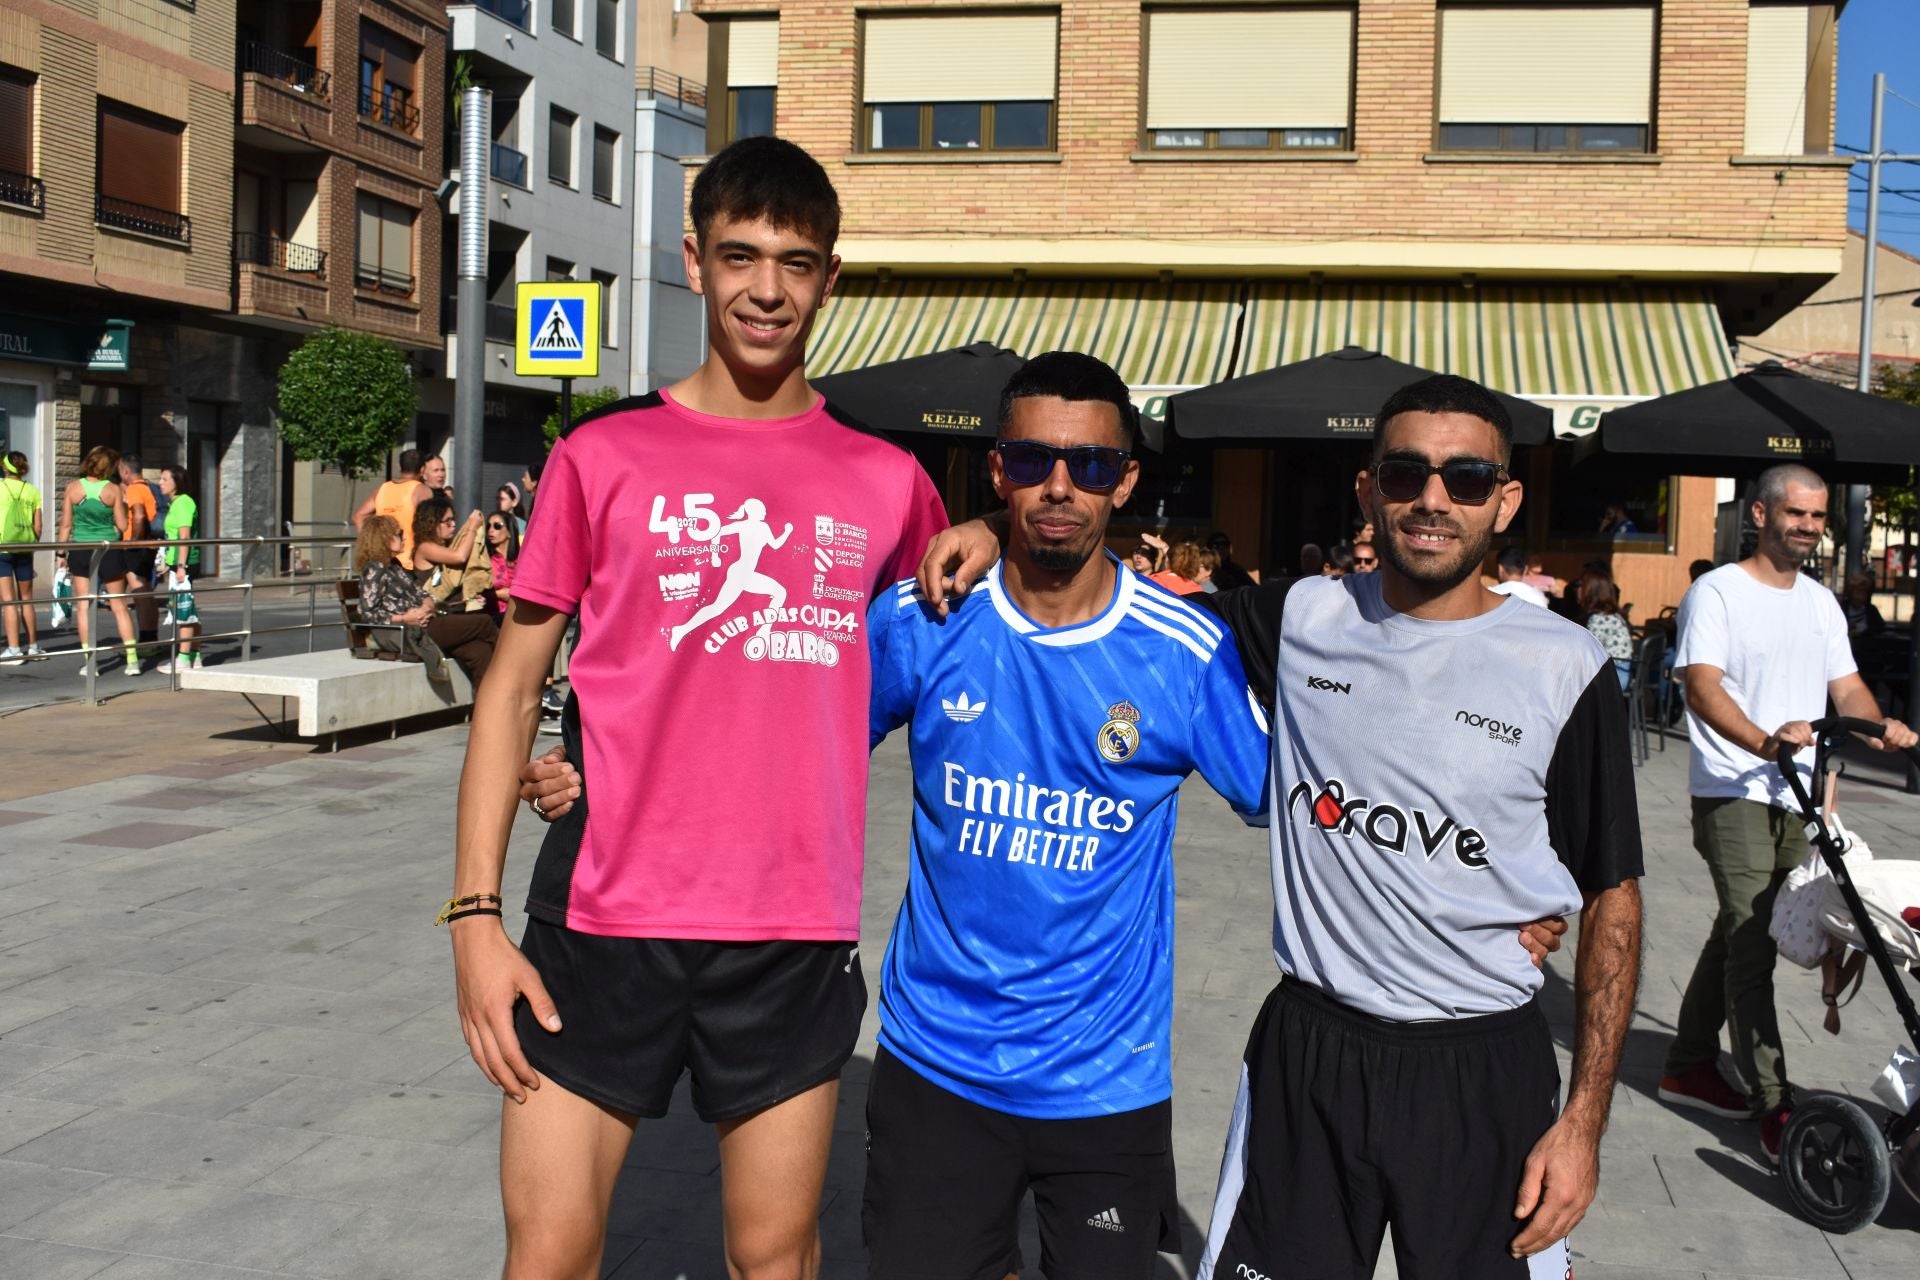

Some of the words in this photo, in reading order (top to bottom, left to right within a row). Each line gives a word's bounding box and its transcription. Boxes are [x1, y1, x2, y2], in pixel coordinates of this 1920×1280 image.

[922, 413, 981, 426] KELER
[1327, 417, 1376, 427] KELE
[1569, 406, 1601, 429] G
[648, 493, 721, 544] 45
[843, 529, 867, 540] BARCO
[655, 544, 729, 558] ANIVERSARIO
[658, 571, 701, 592] NON
[800, 604, 859, 632] CUPA
[704, 616, 749, 654] CLUB
[753, 607, 799, 626] ADAS
[744, 635, 767, 661] O
[769, 630, 839, 667] BARCO
[1455, 711, 1523, 740] norave
[1488, 732, 1520, 747] SPORT
[944, 761, 1135, 833] Emirates
[958, 818, 1004, 858] FLY
[1007, 826, 1100, 871] BETTER
[1087, 1218, 1125, 1232] adidas
